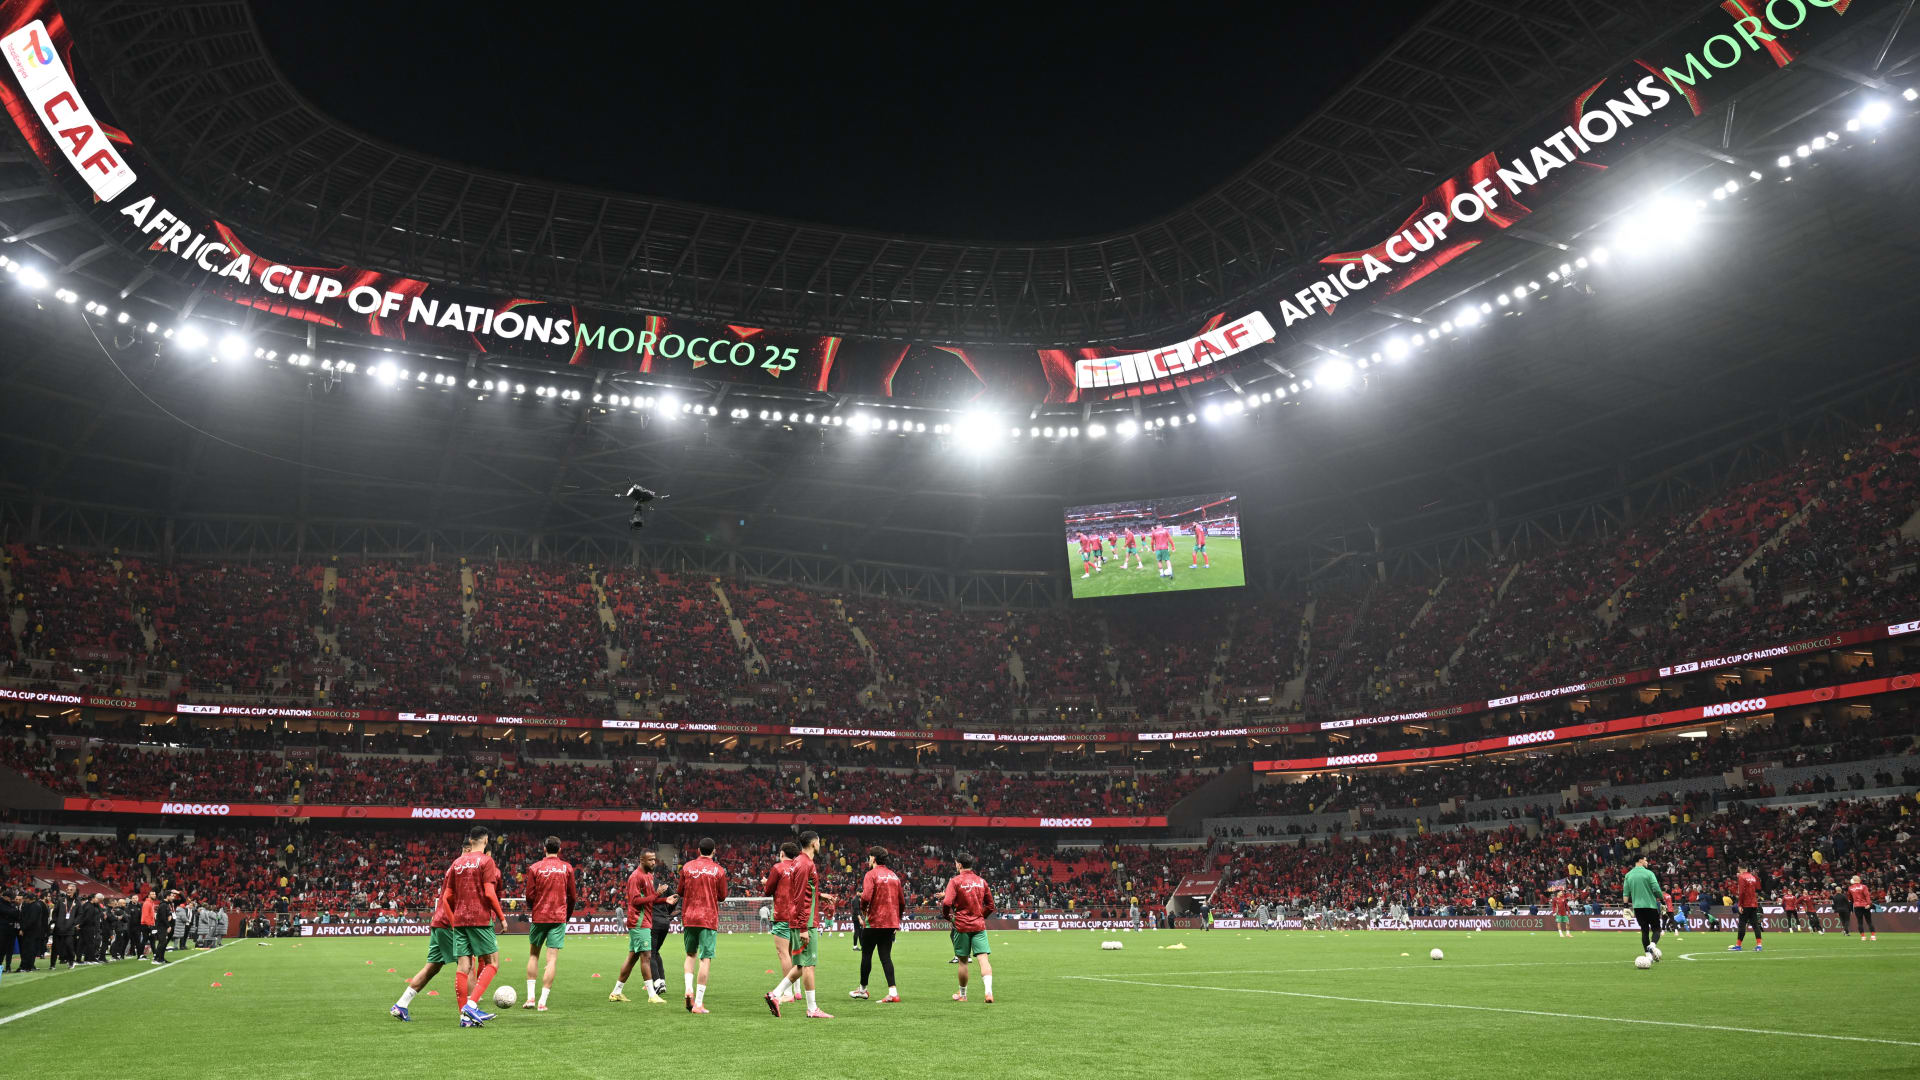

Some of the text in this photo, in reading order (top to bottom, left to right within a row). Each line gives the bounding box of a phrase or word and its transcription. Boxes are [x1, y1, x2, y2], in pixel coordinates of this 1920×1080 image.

[1153, 0, 1841, 372] CAF AFRICA CUP OF NATIONS MORO
[44, 91, 799, 371] CAF AFRICA CUP OF NATIONS MOROCCO 25
[1701, 658, 1726, 668] AFRICA
[1728, 655, 1742, 663] CUP
[1743, 652, 1754, 660] OF
[1755, 646, 1788, 658] NATIONS
[1789, 639, 1830, 652] MOROCCO
[1520, 692, 1540, 701] AFRICA
[1560, 684, 1586, 693] NATIONS
[50, 695, 80, 703] NATION
[1704, 698, 1766, 718] MOROCCO
[1508, 730, 1556, 746] MOROCCO
[1327, 753, 1378, 766] MOROCCO
[161, 803, 230, 815] MOROCCO
[412, 808, 476, 819] MOROCCO
[640, 812, 698, 822] MOROCCO
[1040, 818, 1092, 827] MOROCCO
[454, 858, 480, 874] المغرب
[538, 864, 566, 877] المغرب
[689, 867, 718, 878] المغرب
[960, 880, 984, 892] المغرب
[899, 921, 931, 930] NATIONS
[1242, 920, 1260, 928] AFRICA
[1434, 920, 1447, 928] CUP
[1448, 920, 1457, 928] OF
[1461, 920, 1491, 928] NATIONS
[1492, 920, 1532, 928] MOROCCO
[1535, 920, 1543, 928] 25
[1608, 919, 1635, 927] CAF
[316, 926, 429, 934] AFRICA CUP OF NATIONS
